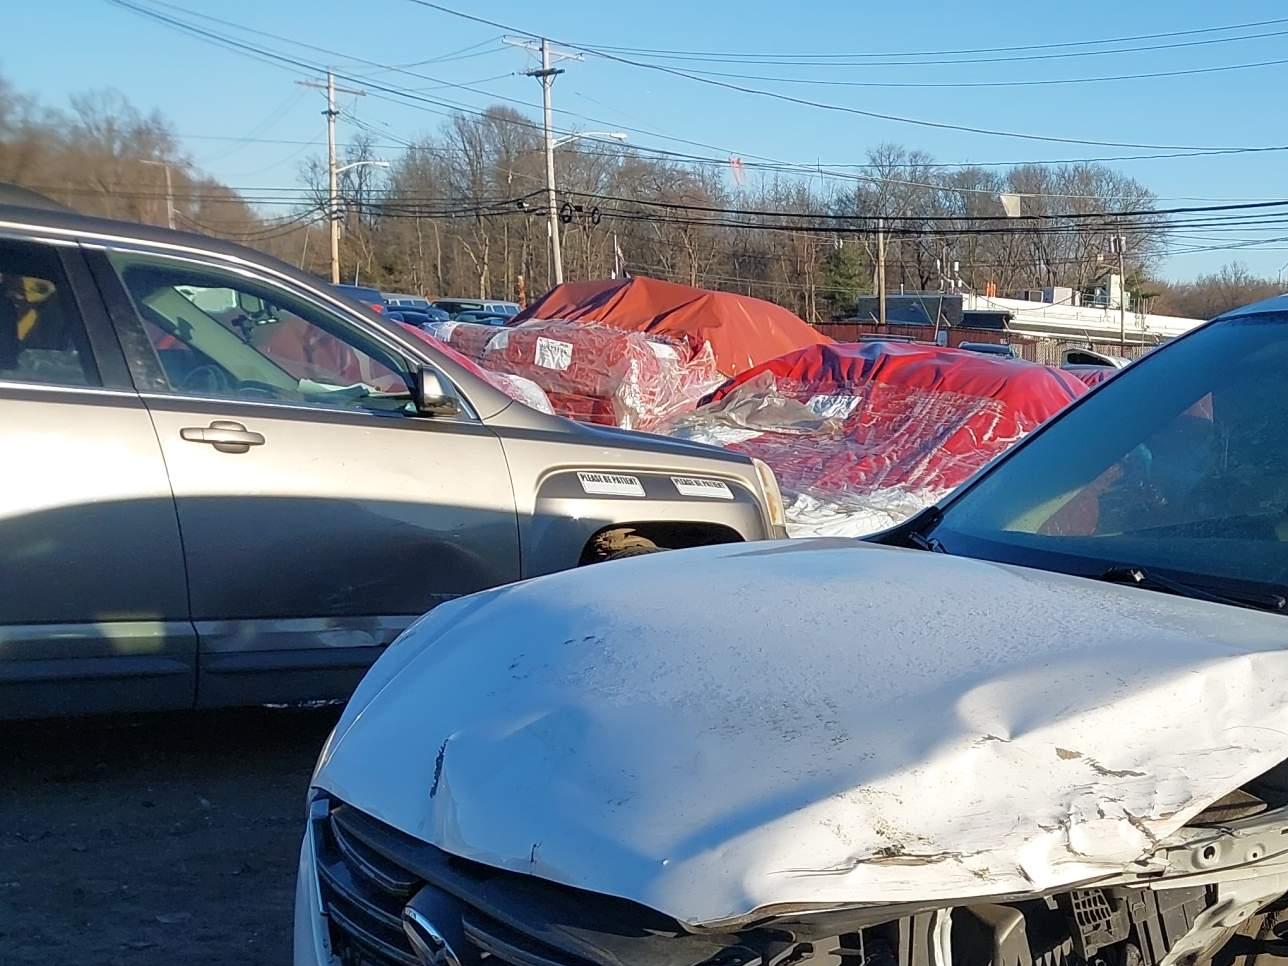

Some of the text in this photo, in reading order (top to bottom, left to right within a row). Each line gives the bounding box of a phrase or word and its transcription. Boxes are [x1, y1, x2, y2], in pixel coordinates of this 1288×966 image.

[580, 473, 638, 486] PLEASE BE PATIENT
[673, 478, 695, 487] PLEASE
